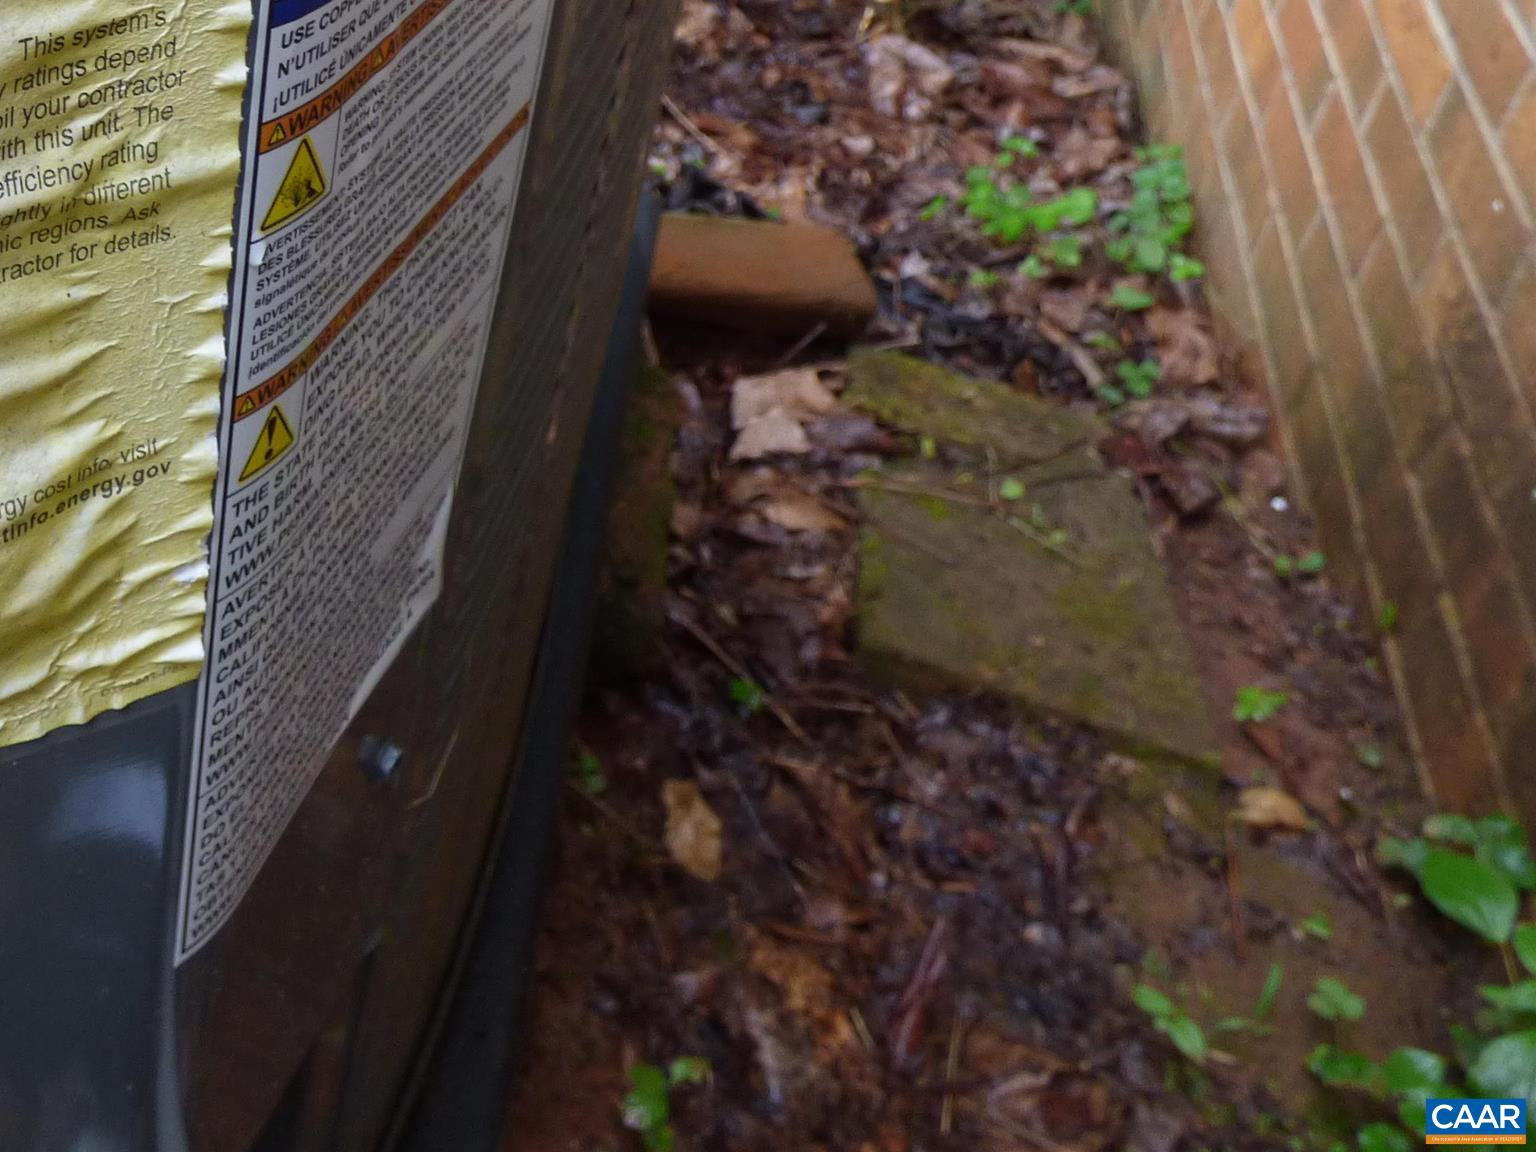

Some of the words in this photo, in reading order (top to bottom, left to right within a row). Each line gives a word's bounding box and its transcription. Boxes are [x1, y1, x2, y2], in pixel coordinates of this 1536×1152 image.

[18, 33, 65, 63] This
[72, 8, 167, 48] system's
[281, 24, 315, 50] USE
[14, 57, 87, 95] ratings
[94, 36, 176, 73] depend
[22, 95, 71, 129] your
[77, 68, 186, 109] contractor
[34, 125, 74, 153] this
[81, 116, 124, 142] unit.
[134, 101, 175, 129] The
[99, 139, 159, 172] rating
[84, 166, 173, 207] different
[120, 200, 160, 222] Ask
[70, 244, 98, 272] for
[104, 223, 176, 256] details.
[33, 474, 73, 504] cost
[119, 438, 159, 464] visit
[231, 481, 269, 518] THE
[229, 507, 269, 545] AND
[228, 529, 266, 566] TIVE
